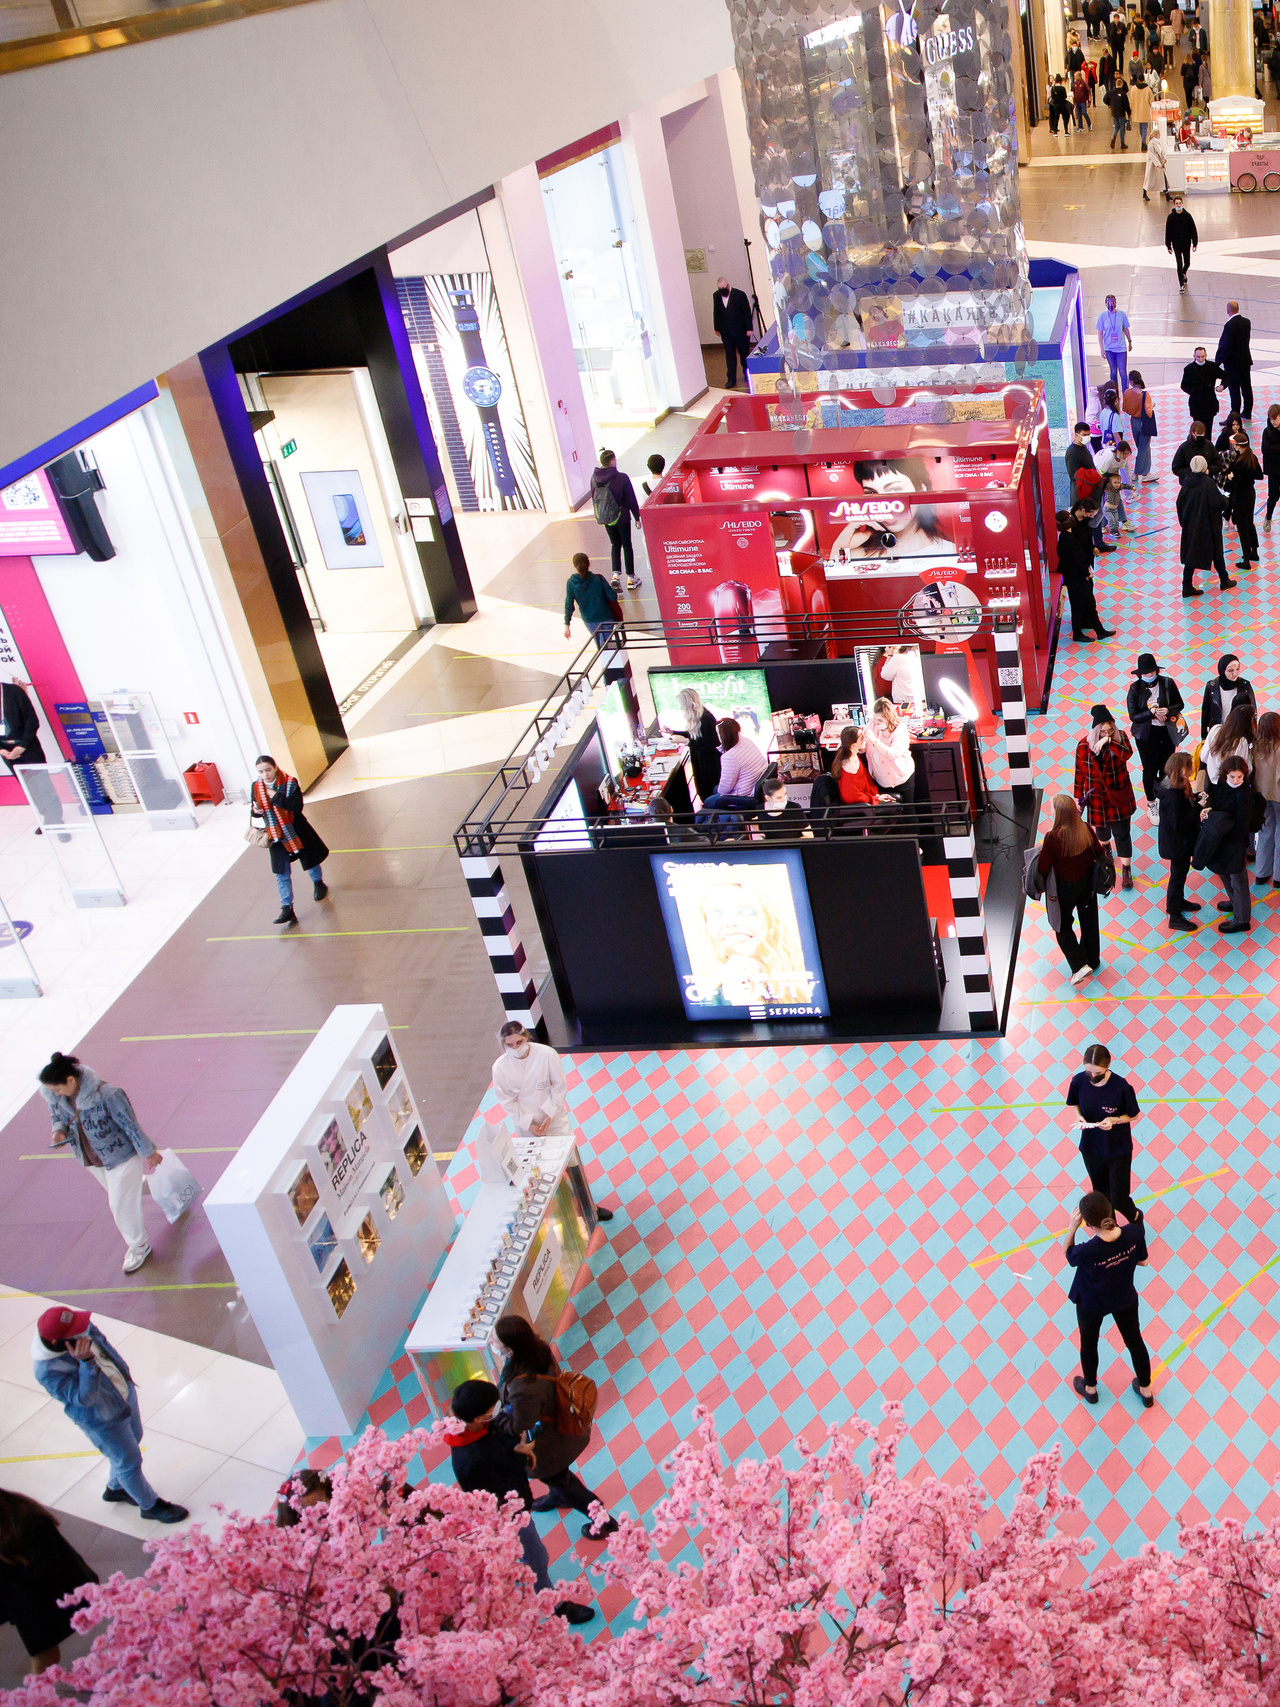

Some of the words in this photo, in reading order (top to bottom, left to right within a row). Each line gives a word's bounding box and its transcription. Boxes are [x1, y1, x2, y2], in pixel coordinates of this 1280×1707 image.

[926, 26, 974, 65] GUESS
[720, 483, 754, 491] Ultimune
[829, 500, 905, 517] SHISEIDO
[719, 520, 762, 530] SHISEIDO
[664, 545, 699, 553] Ultimune
[769, 1007, 821, 1015] SEPHORA
[331, 1131, 367, 1191] REPLICA
[532, 1248, 551, 1290] REPLICA
